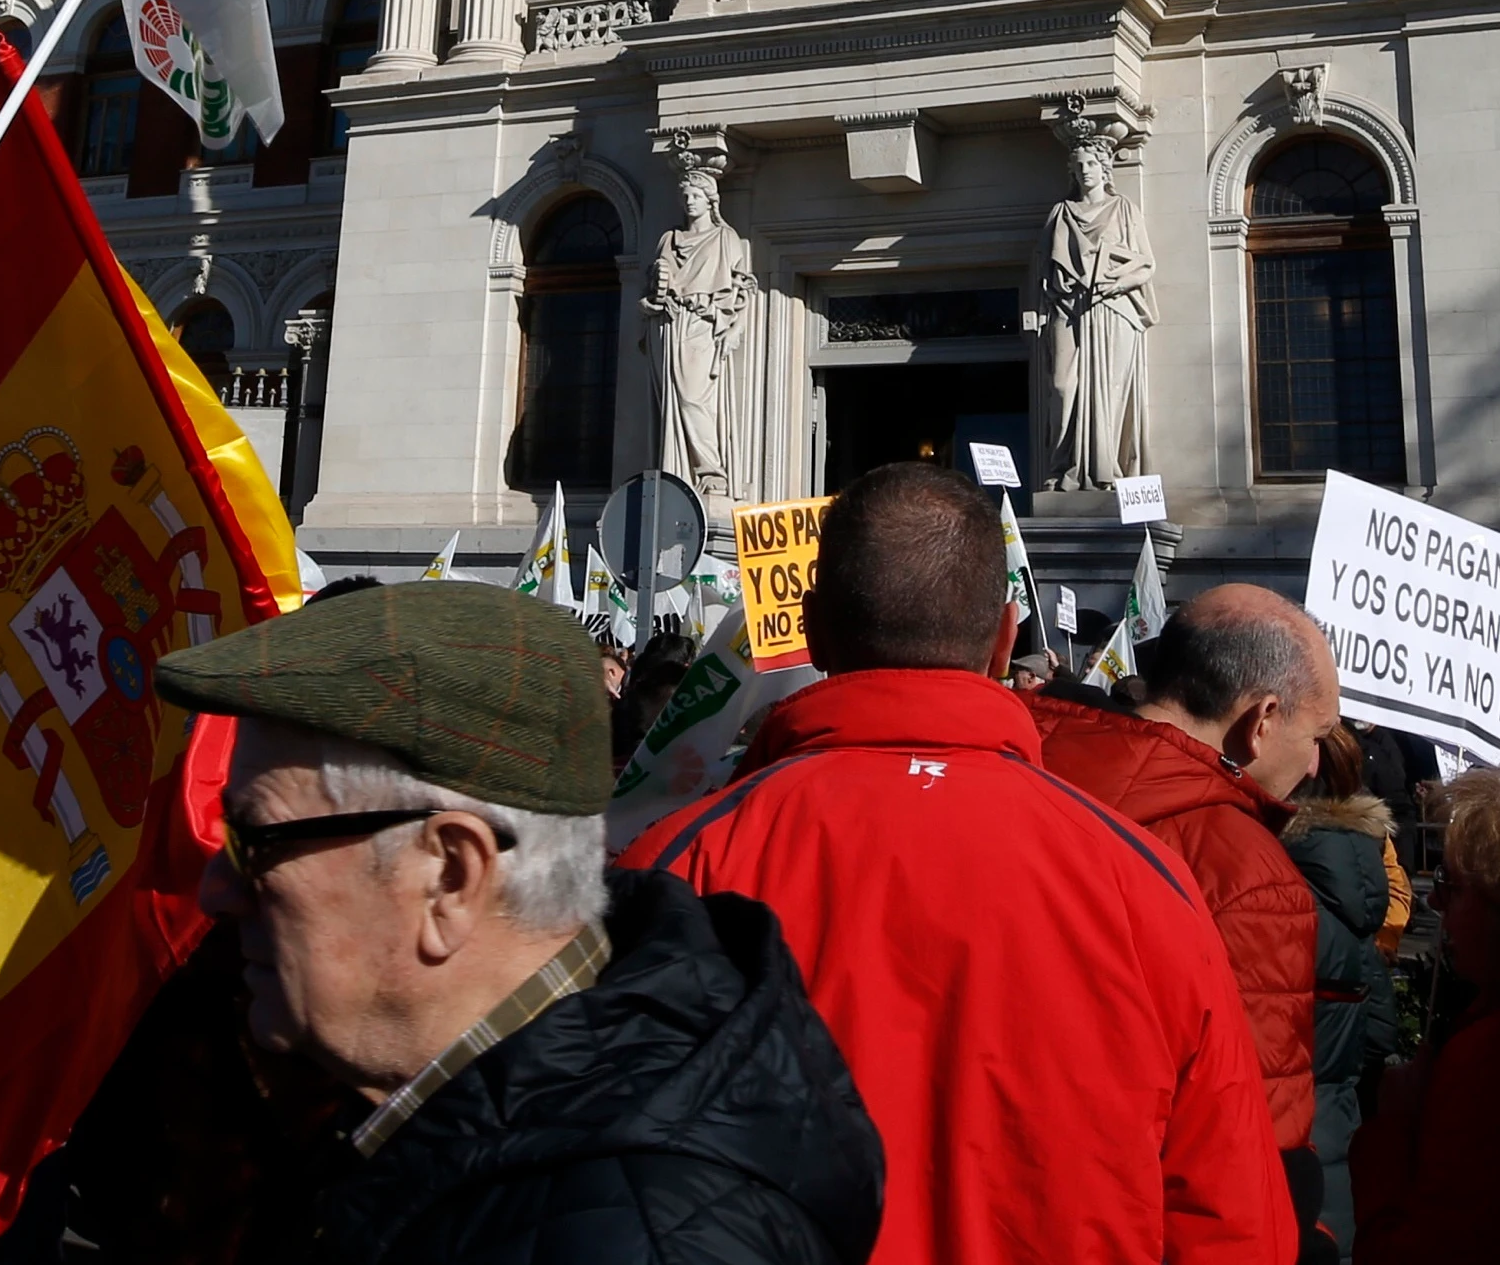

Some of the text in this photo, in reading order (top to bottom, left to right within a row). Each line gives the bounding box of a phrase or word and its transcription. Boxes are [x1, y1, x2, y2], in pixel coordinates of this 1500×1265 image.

[740, 510, 788, 553] NOS
[1366, 508, 1418, 561] NOS
[747, 567, 763, 605] Y
[769, 562, 803, 602] OS
[1332, 559, 1348, 601] Y
[1351, 569, 1387, 615] OS
[1395, 582, 1500, 653] COBRAN
[757, 611, 792, 647] ¡NO
[1323, 622, 1414, 695] NIDOS,
[1425, 652, 1456, 700] YA
[1465, 663, 1495, 714] NO
